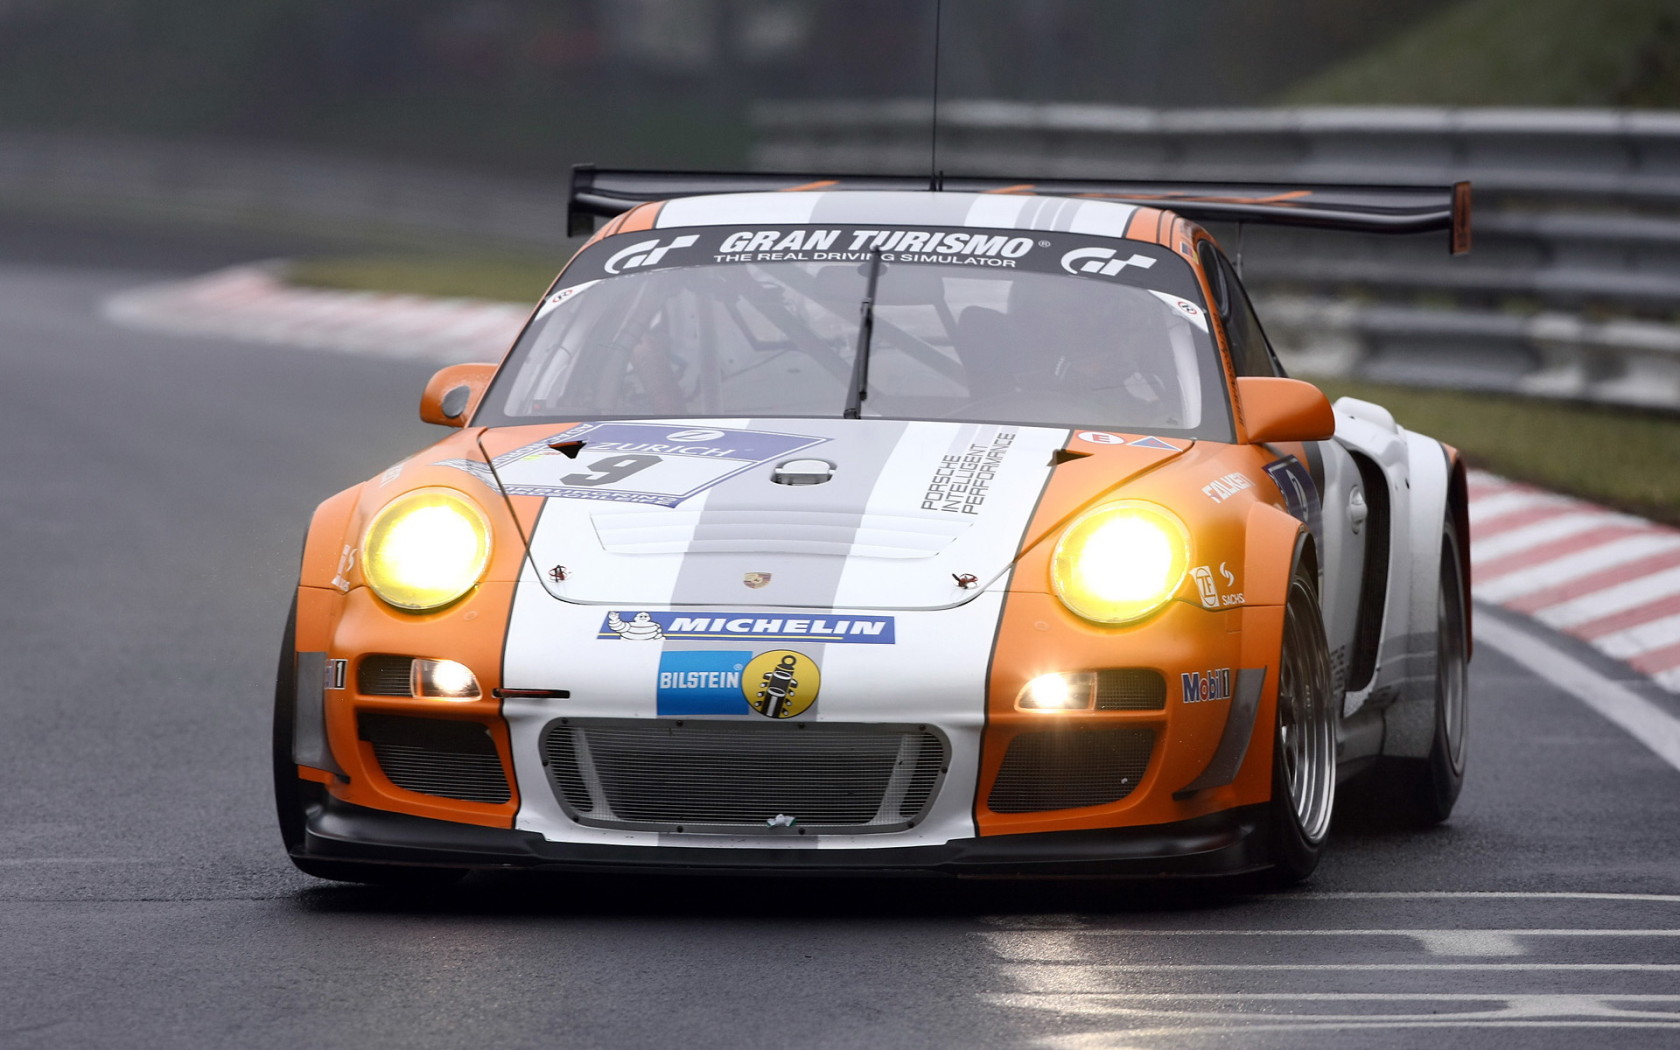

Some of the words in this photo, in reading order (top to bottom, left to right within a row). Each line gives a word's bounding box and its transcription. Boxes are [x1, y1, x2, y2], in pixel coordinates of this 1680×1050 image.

[719, 230, 841, 253] GRAN
[848, 230, 1034, 258] TURISMO
[714, 253, 752, 262] THE
[757, 252, 808, 261] REAL
[900, 253, 1016, 268] SIMULATOR
[588, 442, 736, 457] ZURICH
[560, 454, 663, 486] 9
[941, 443, 983, 513] INTELLIGENT
[961, 432, 1016, 515] PERFORMANCE
[921, 454, 961, 511] PORSCHE
[1222, 593, 1245, 606] SACHS
[668, 617, 887, 635] MICHELIN
[660, 671, 739, 689] BILSTEIN
